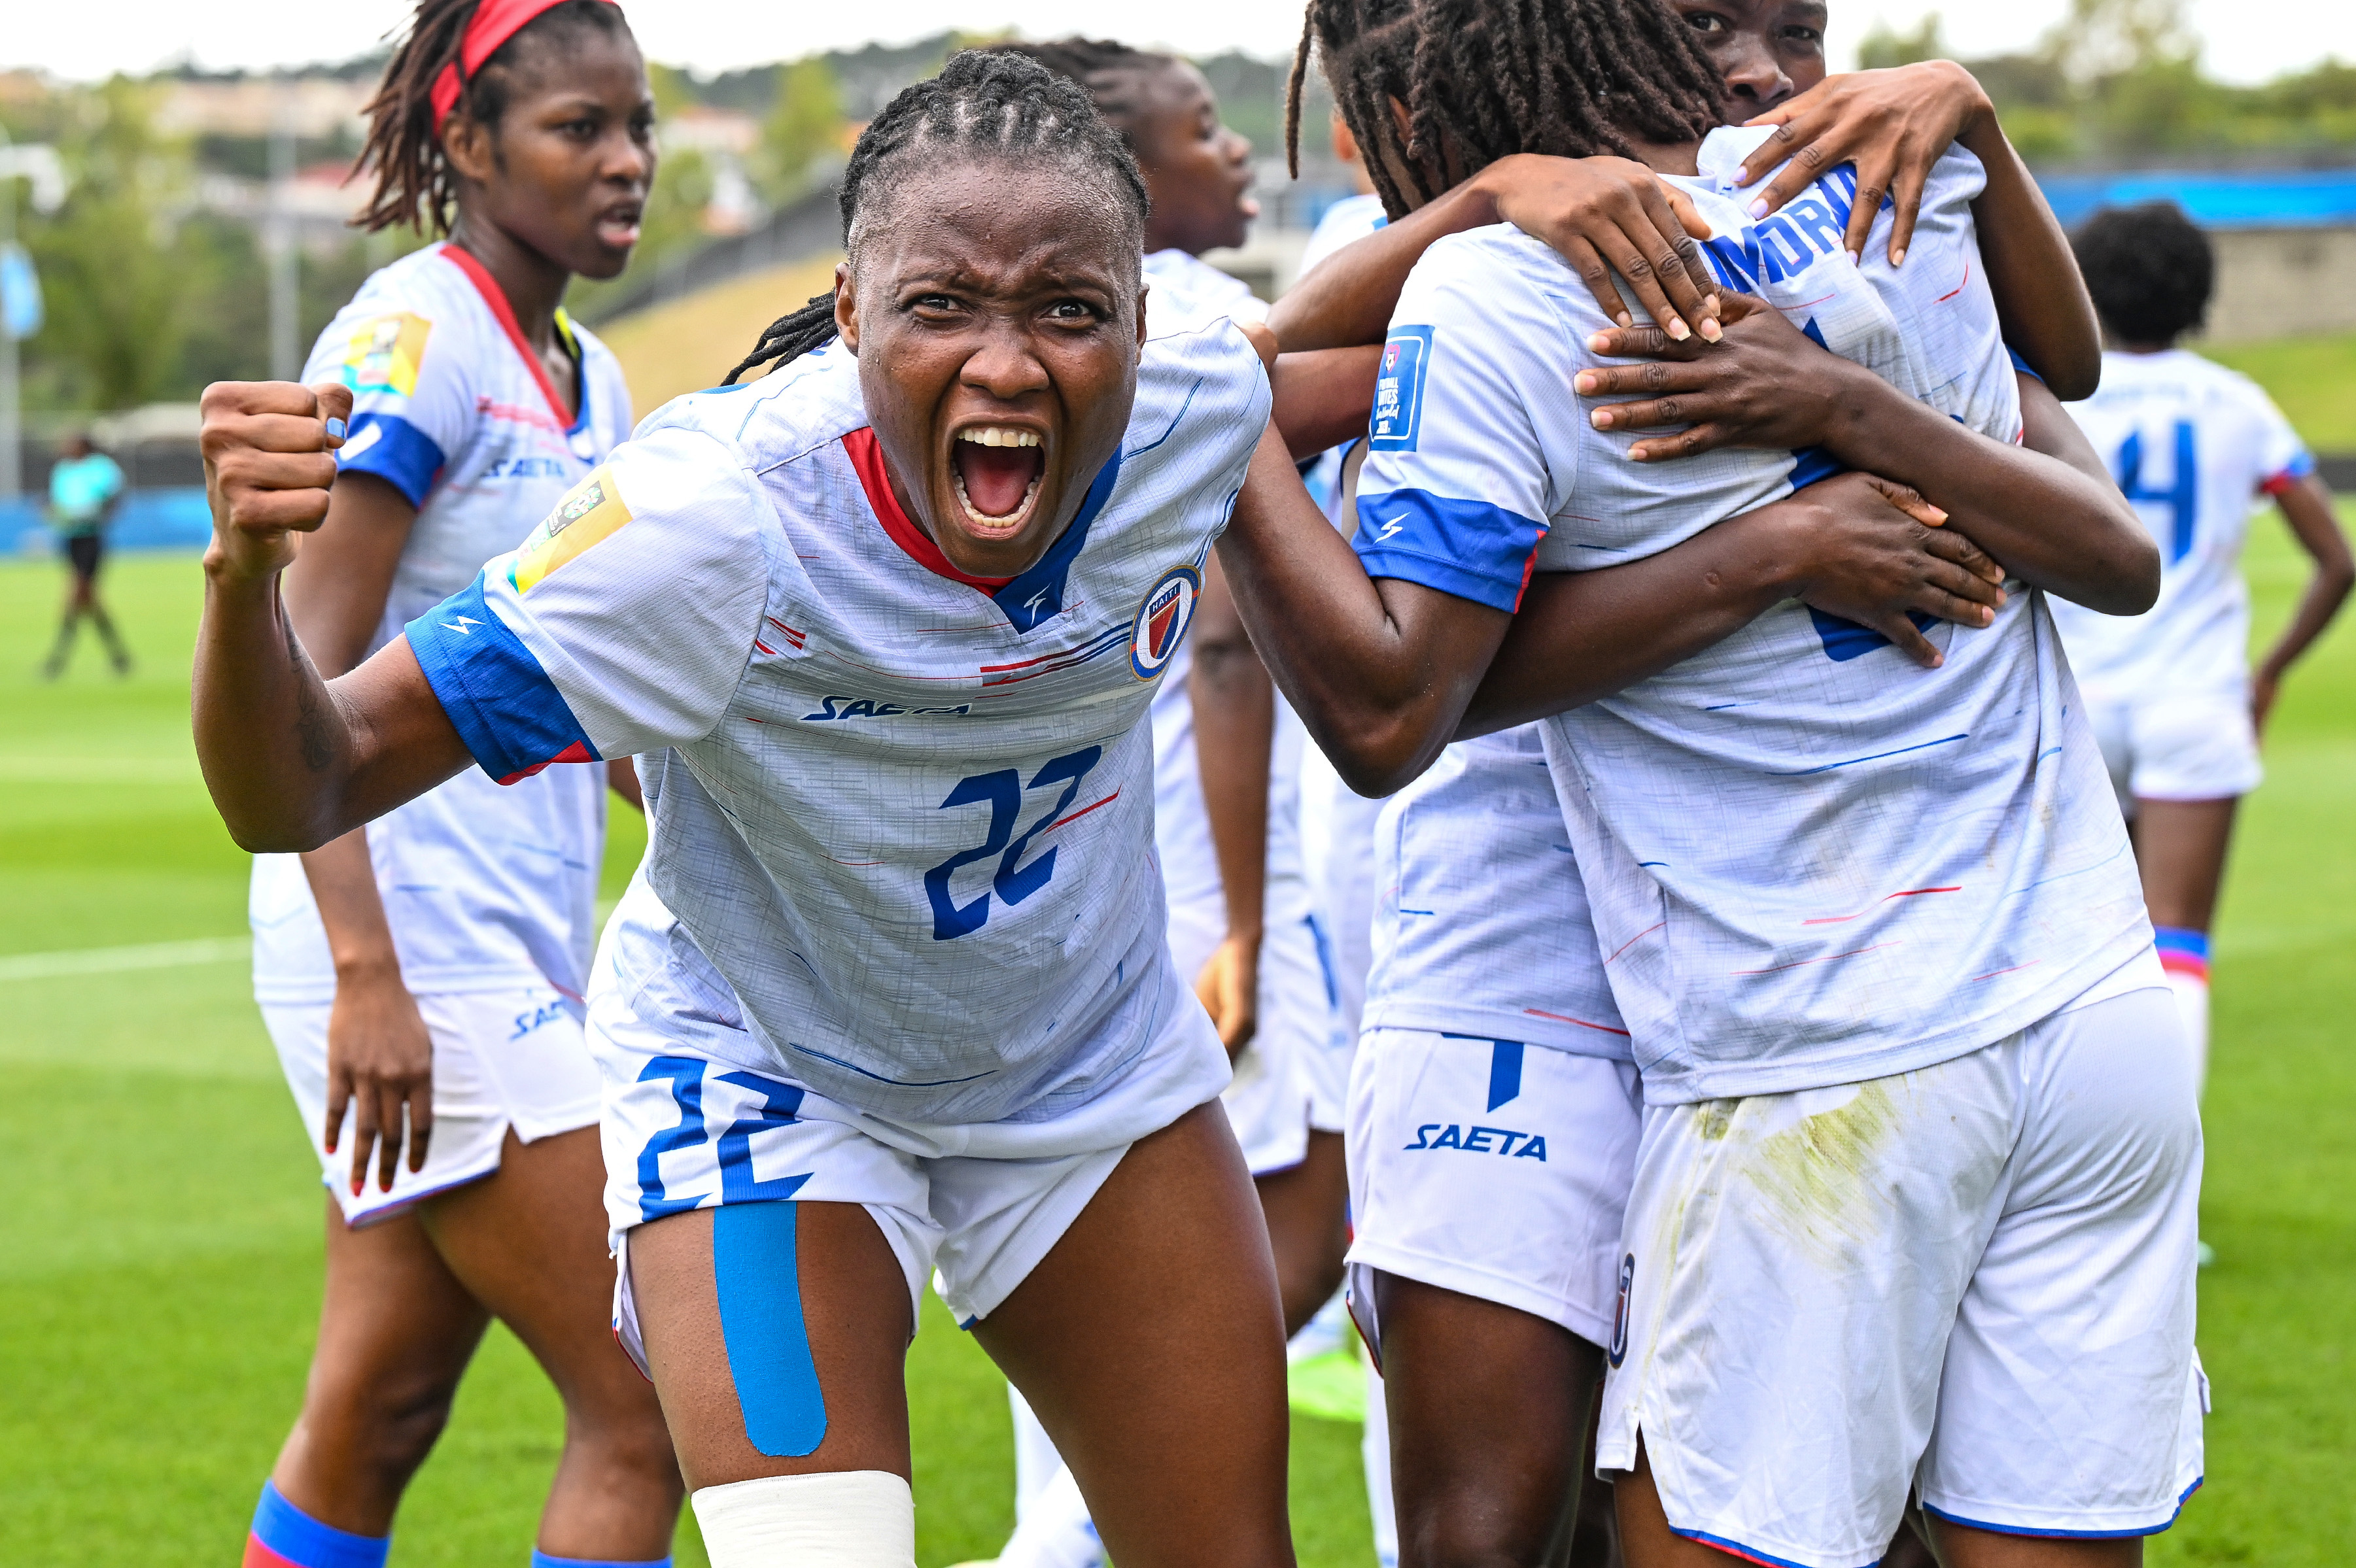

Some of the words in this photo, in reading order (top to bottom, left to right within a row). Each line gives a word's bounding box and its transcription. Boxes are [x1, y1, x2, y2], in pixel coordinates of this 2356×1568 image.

[1700, 161, 1894, 294] MORN
[2117, 418, 2197, 568] 4
[1152, 587, 1177, 612] HAITI
[924, 745, 1102, 940] 22
[636, 1055, 815, 1222] 22
[1403, 1123, 1546, 1163] SAETA
